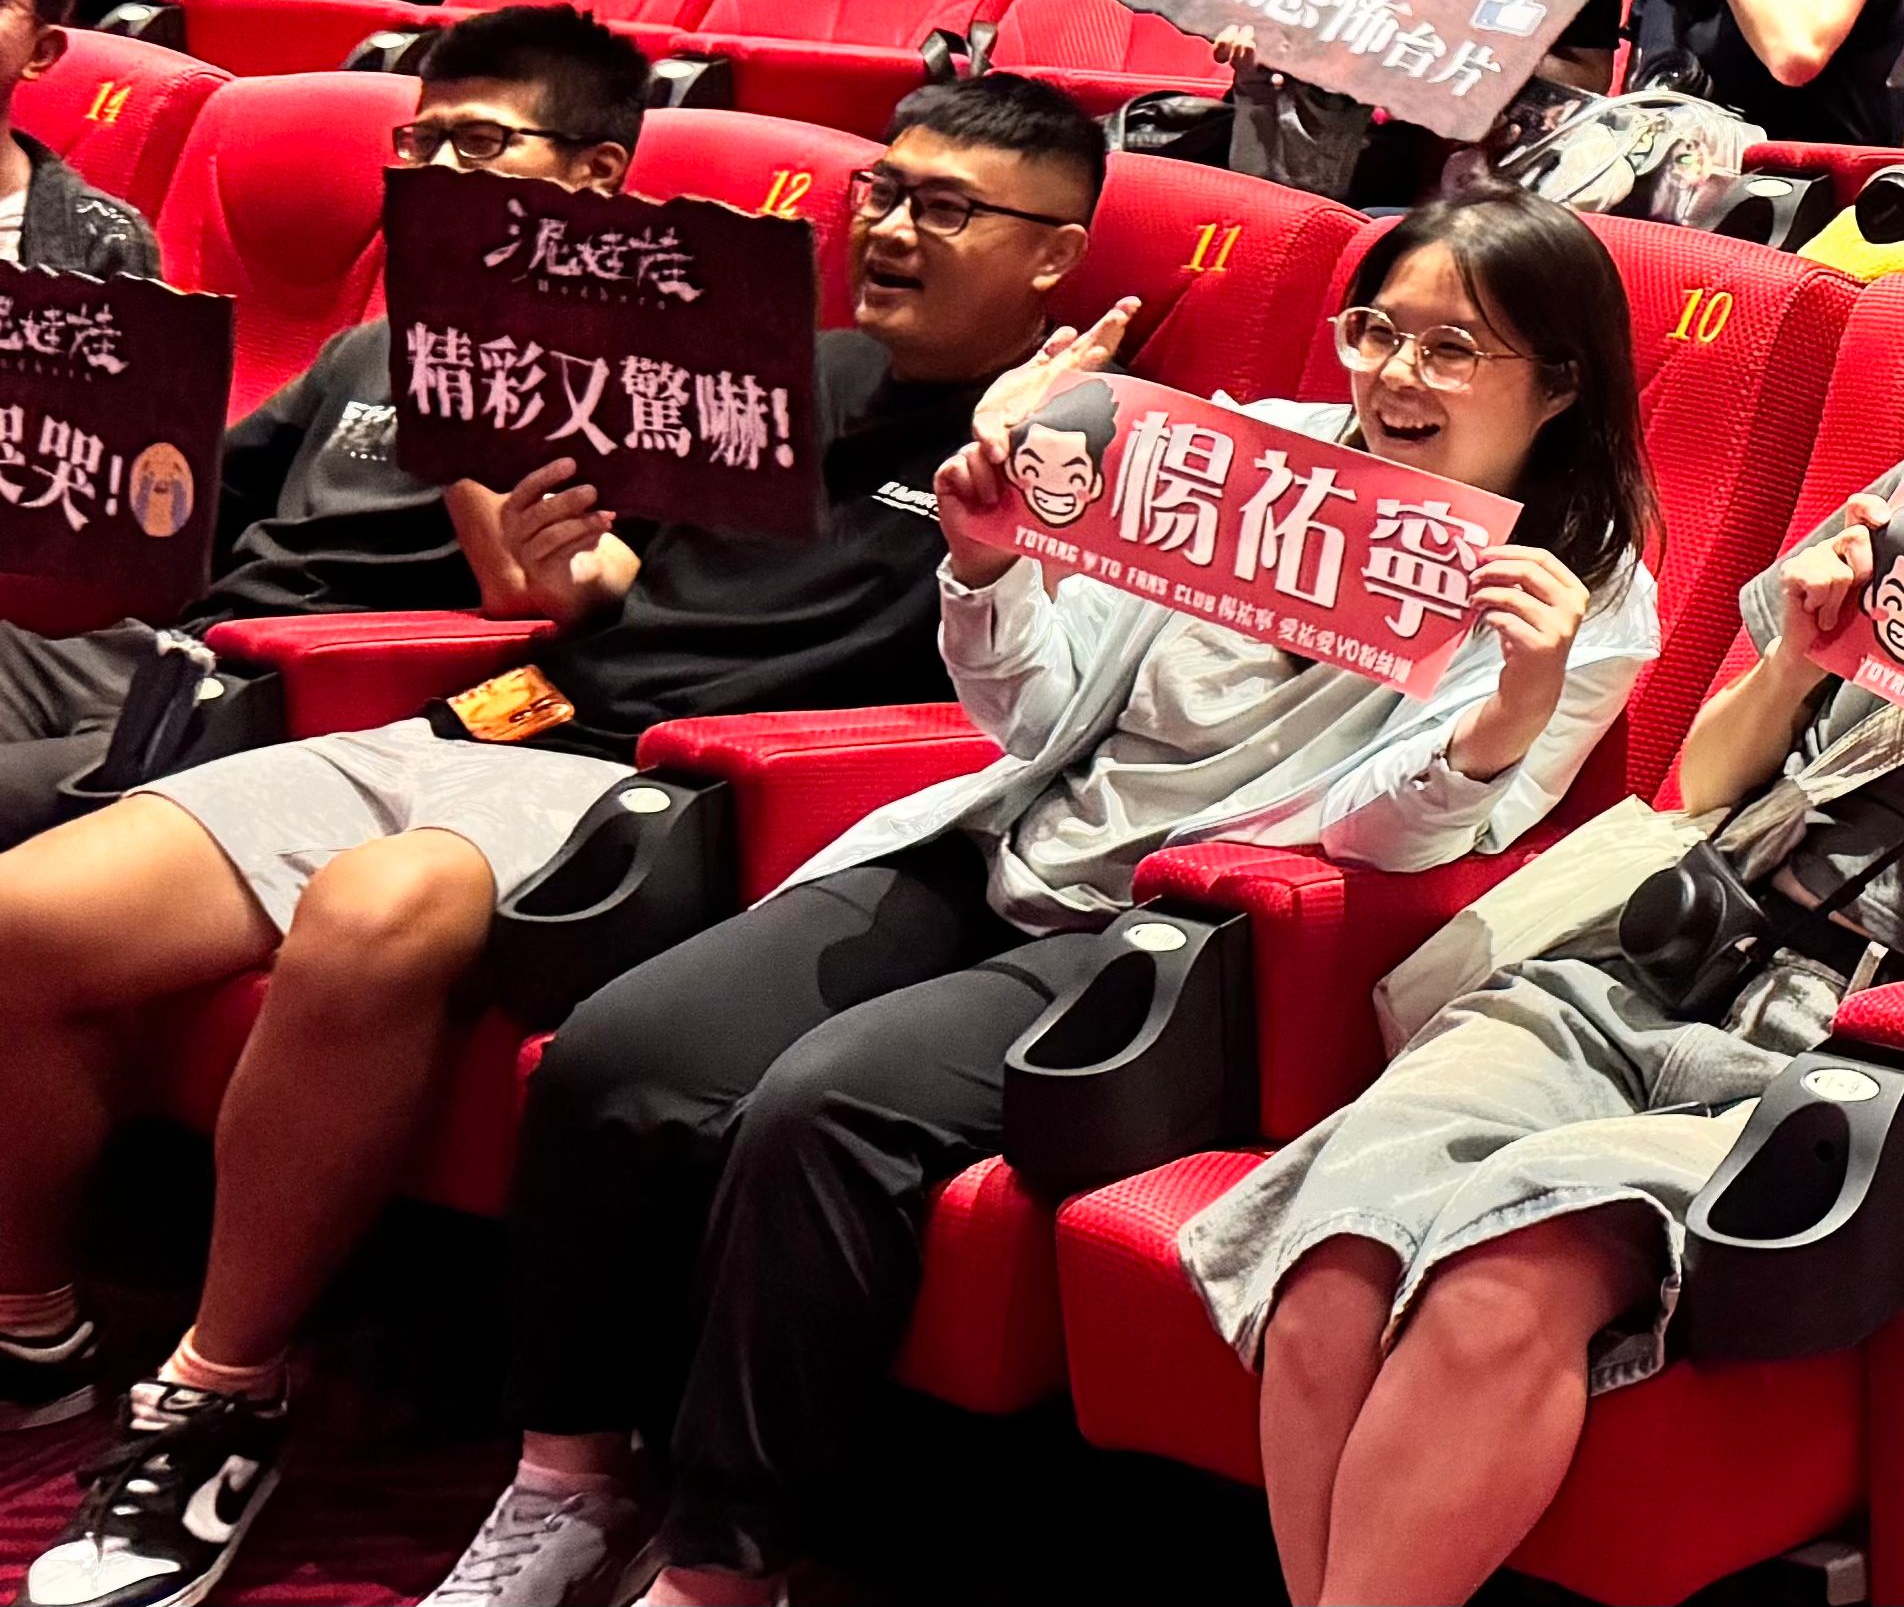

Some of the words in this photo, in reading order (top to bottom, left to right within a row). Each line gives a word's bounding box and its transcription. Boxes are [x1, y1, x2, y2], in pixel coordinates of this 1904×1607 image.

[89, 84, 128, 122] 14
[762, 172, 810, 218] 12
[483, 198, 704, 302] 泥娃娃
[1192, 226, 1238, 270] 11
[1674, 291, 1731, 341] 10
[405, 321, 796, 471] 精彩又驚嚇!
[1111, 408, 1491, 639] 楊祐寧
[1126, 567, 1169, 597] FANS
[1174, 584, 1217, 613] CLUB
